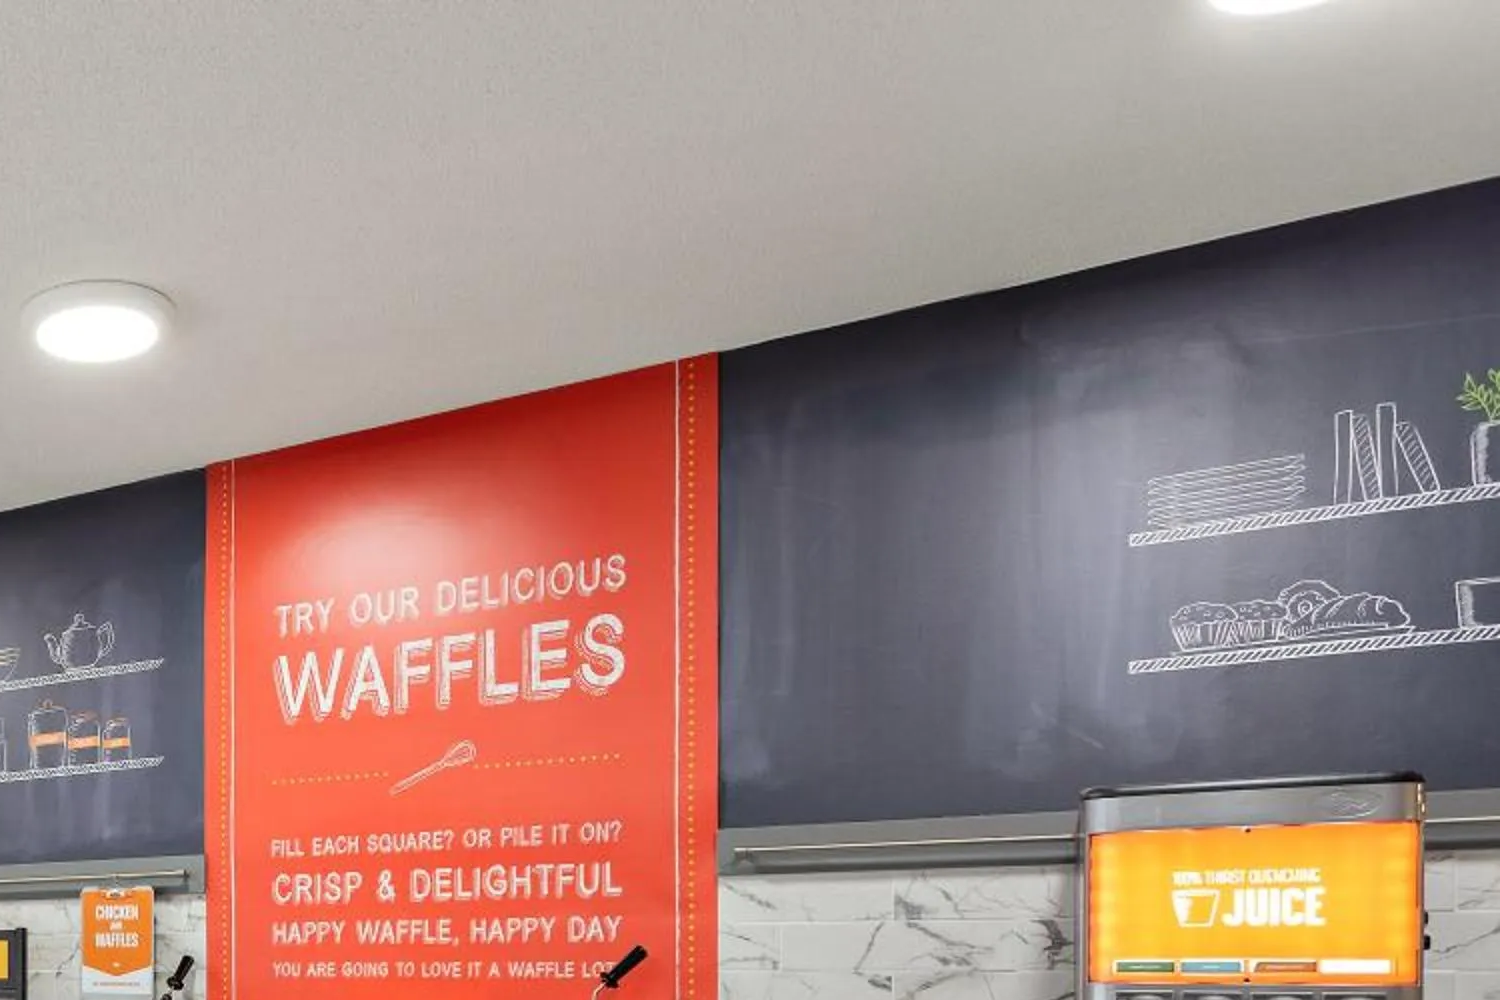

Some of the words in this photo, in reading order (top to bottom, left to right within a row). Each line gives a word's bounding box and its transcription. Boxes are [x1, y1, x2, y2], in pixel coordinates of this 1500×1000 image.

[276, 601, 337, 639] TRY
[349, 587, 420, 626] OUR
[436, 554, 627, 613] DELICIOUS
[273, 613, 627, 725] WAFFLES
[271, 837, 305, 858] FILL
[312, 833, 360, 856] EACH
[366, 829, 453, 854] SQUARE?
[463, 828, 492, 849] OR
[501, 825, 543, 847] PILE
[551, 824, 570, 845] IT
[580, 821, 623, 844] ON?
[272, 870, 363, 906] CRISP
[376, 869, 396, 901] &
[410, 861, 623, 901] DELIGHTFUL
[95, 904, 139, 921] CHICKEN
[1222, 887, 1327, 927] JUICE
[95, 931, 139, 949] WAFFLES
[272, 920, 346, 946] HAPPY
[356, 918, 460, 947] WAFFLE,
[470, 917, 557, 944] HAPPY
[568, 915, 623, 943] DAY
[273, 962, 302, 979] YOU
[307, 962, 337, 979] ARE
[342, 961, 389, 979] GOING
[397, 961, 415, 979] TO
[421, 961, 462, 979] LOVE
[467, 961, 483, 979] IT
[489, 961, 500, 978] A
[508, 961, 575, 979] WAFFLE
